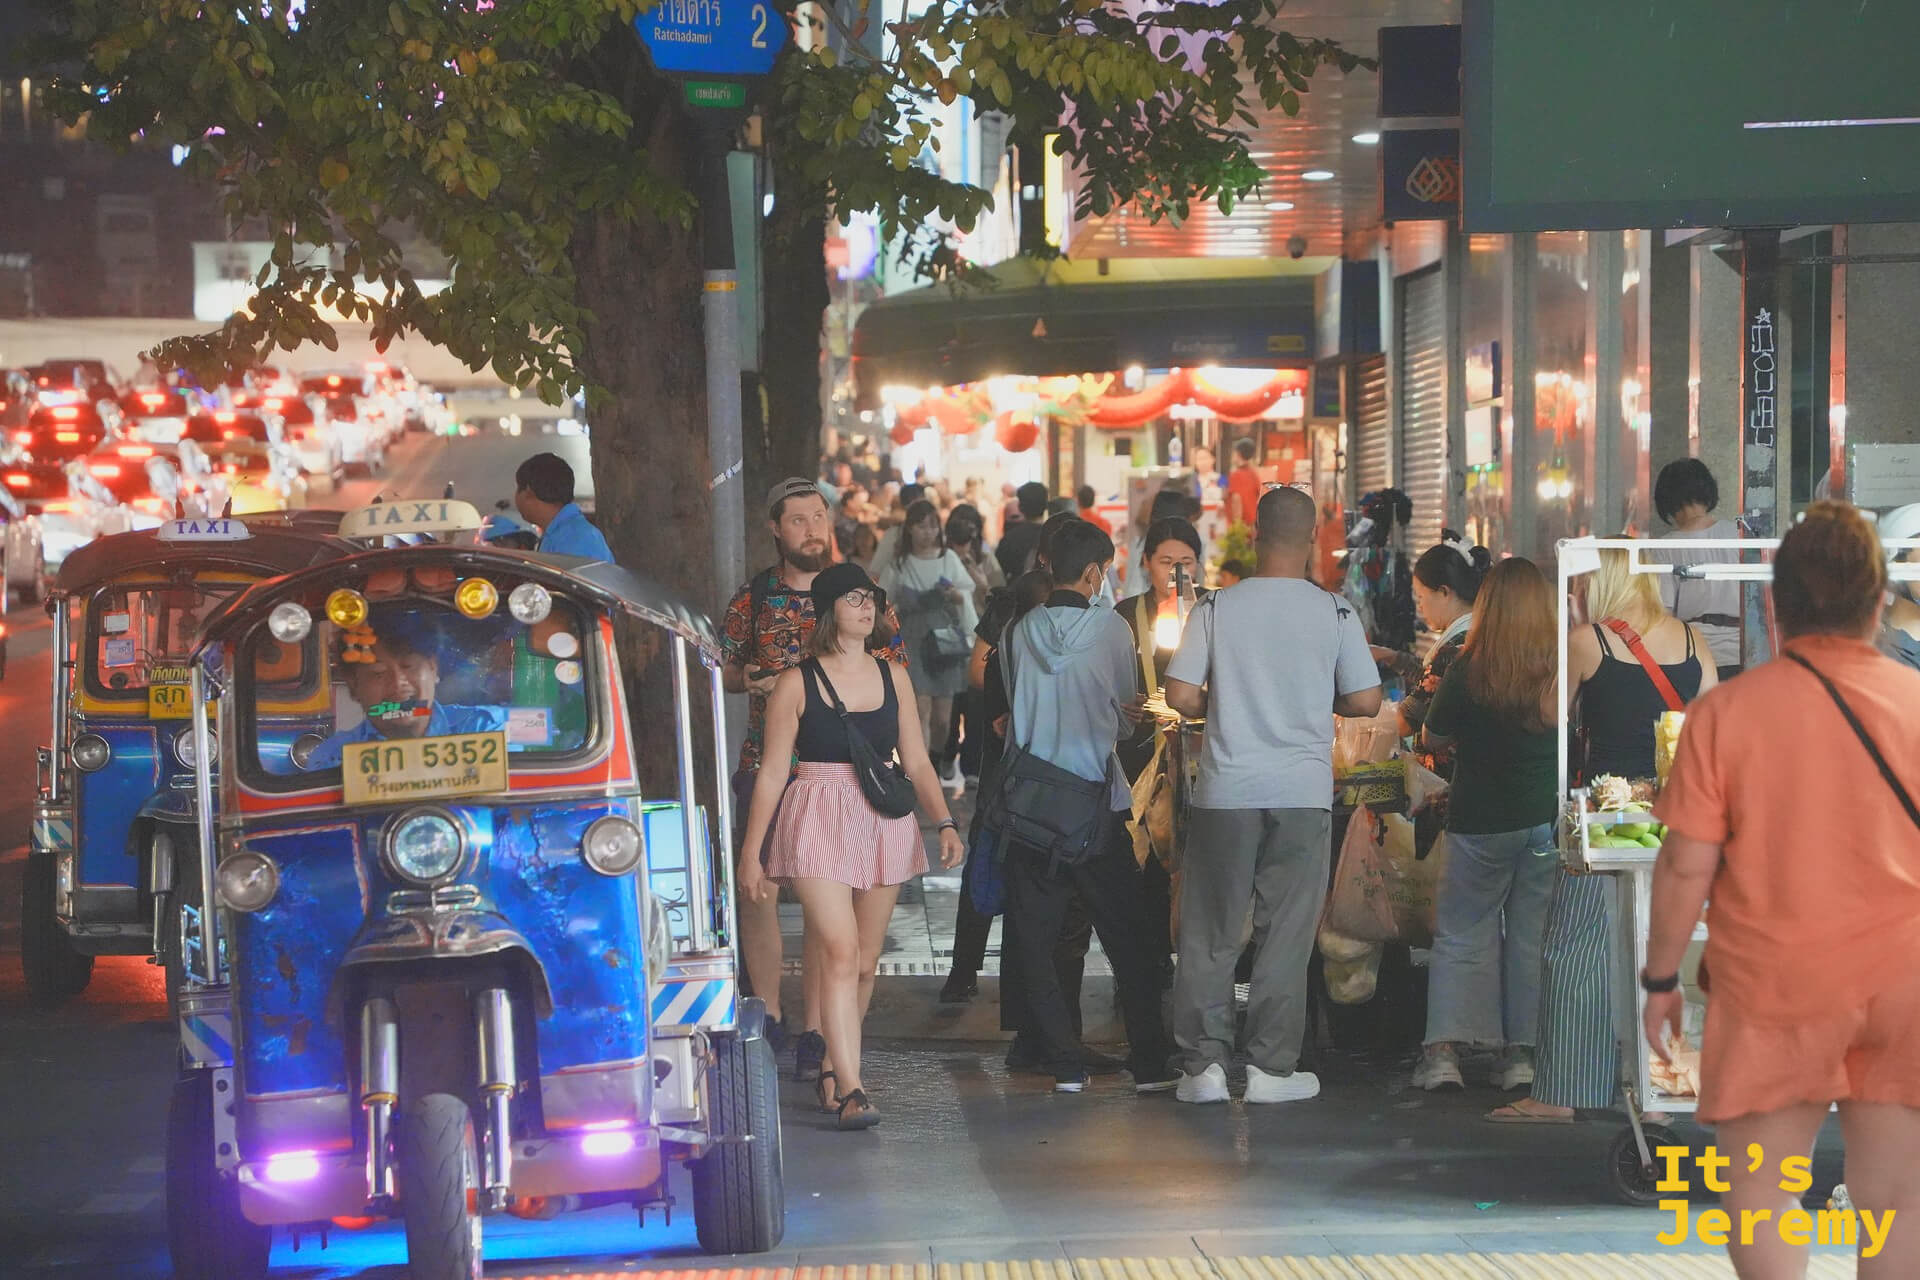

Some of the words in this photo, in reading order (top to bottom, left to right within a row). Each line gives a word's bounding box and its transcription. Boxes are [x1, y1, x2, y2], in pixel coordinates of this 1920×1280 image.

[654, 27, 713, 44] Ratchadamri
[751, 4, 768, 49] 2
[365, 503, 449, 526] TAXI
[175, 520, 230, 534] TAXI
[359, 746, 404, 774] สก
[422, 738, 499, 768] 5352
